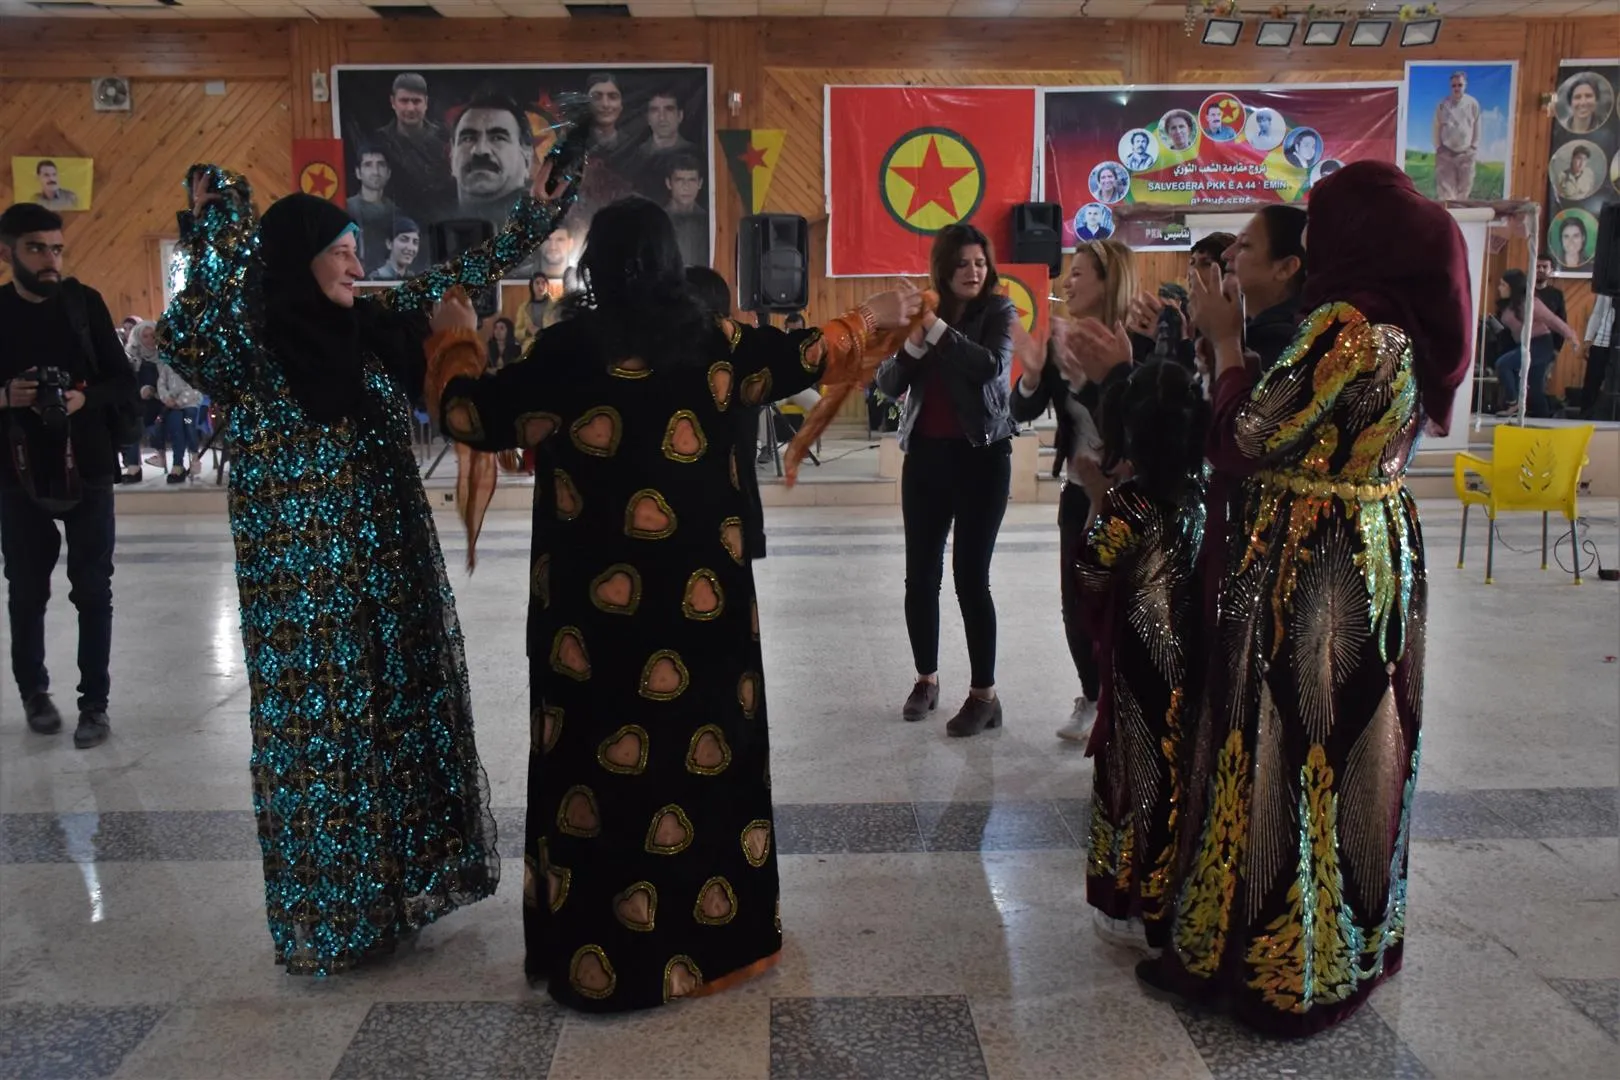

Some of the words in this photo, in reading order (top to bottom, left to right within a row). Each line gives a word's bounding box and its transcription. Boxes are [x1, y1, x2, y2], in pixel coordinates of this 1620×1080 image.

[1199, 163, 1221, 174] الشعب
[1223, 162, 1247, 174] مقاومة
[1148, 181, 1205, 191] SALVEGERA
[1206, 181, 1226, 190] PKK
[1236, 181, 1244, 190] A
[1245, 181, 1256, 190] 44
